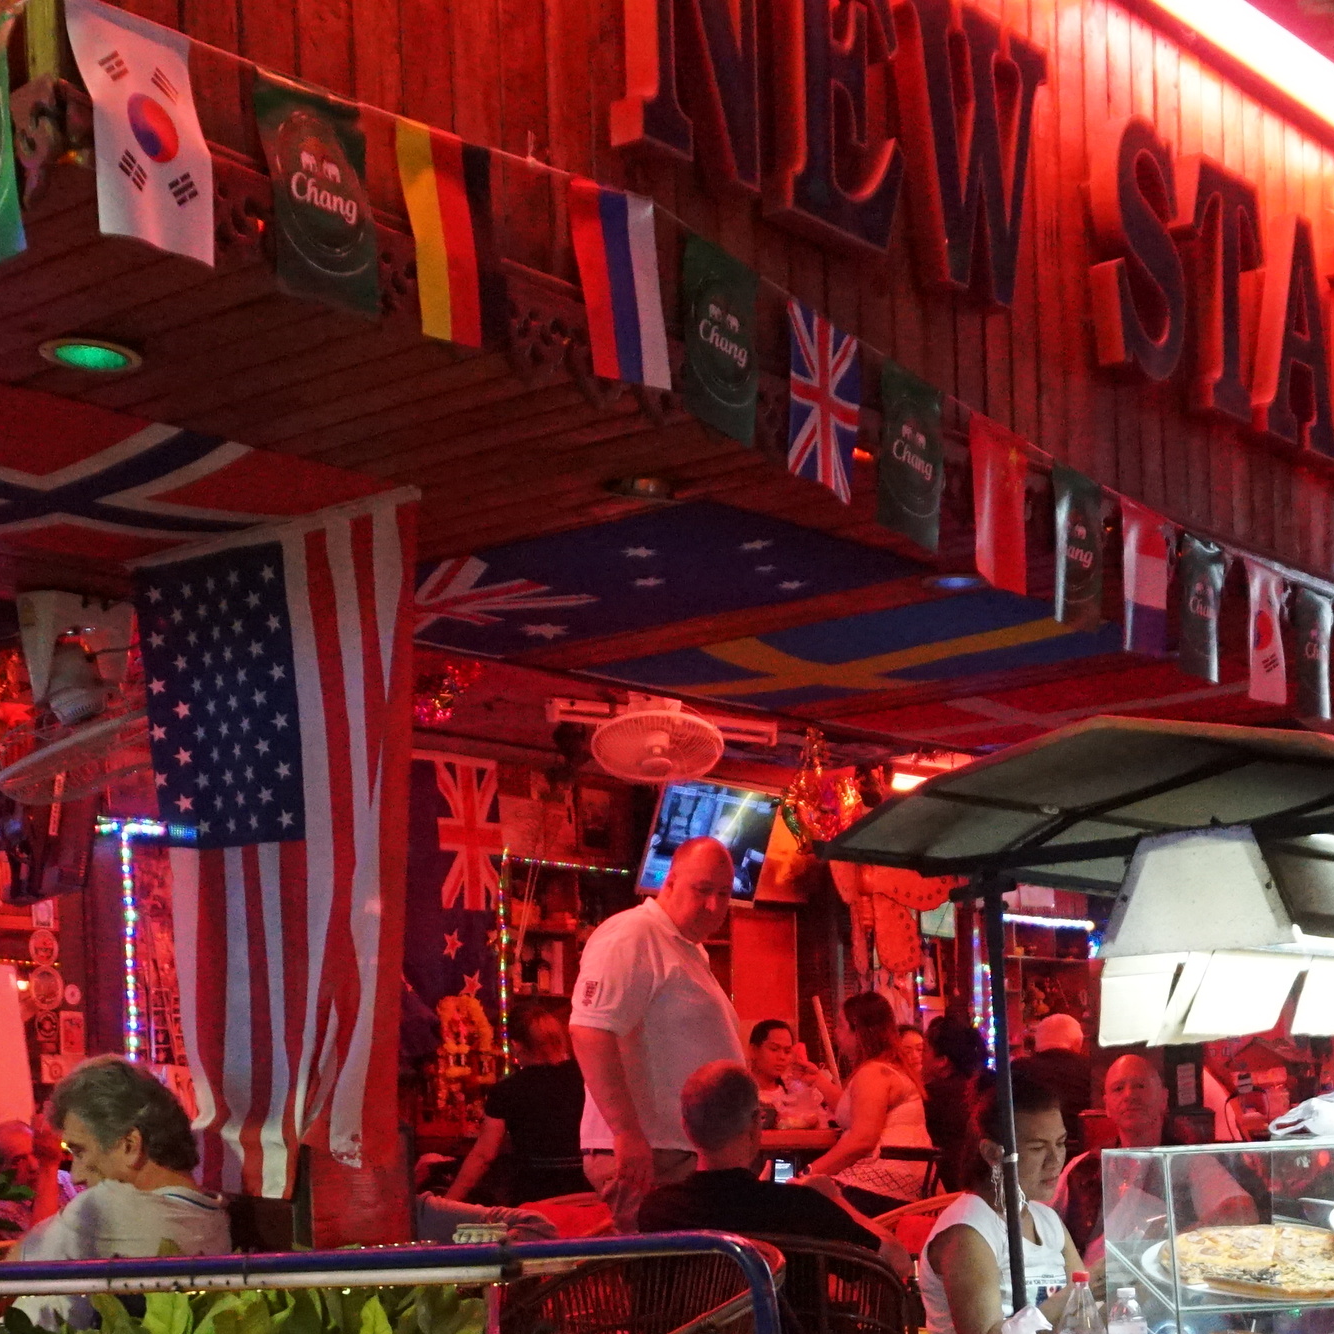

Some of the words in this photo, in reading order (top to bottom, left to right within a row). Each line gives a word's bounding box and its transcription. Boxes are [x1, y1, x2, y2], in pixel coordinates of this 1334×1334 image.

[291, 171, 358, 225] Chang
[698, 318, 749, 369] Chang
[892, 440, 934, 481] Chang
